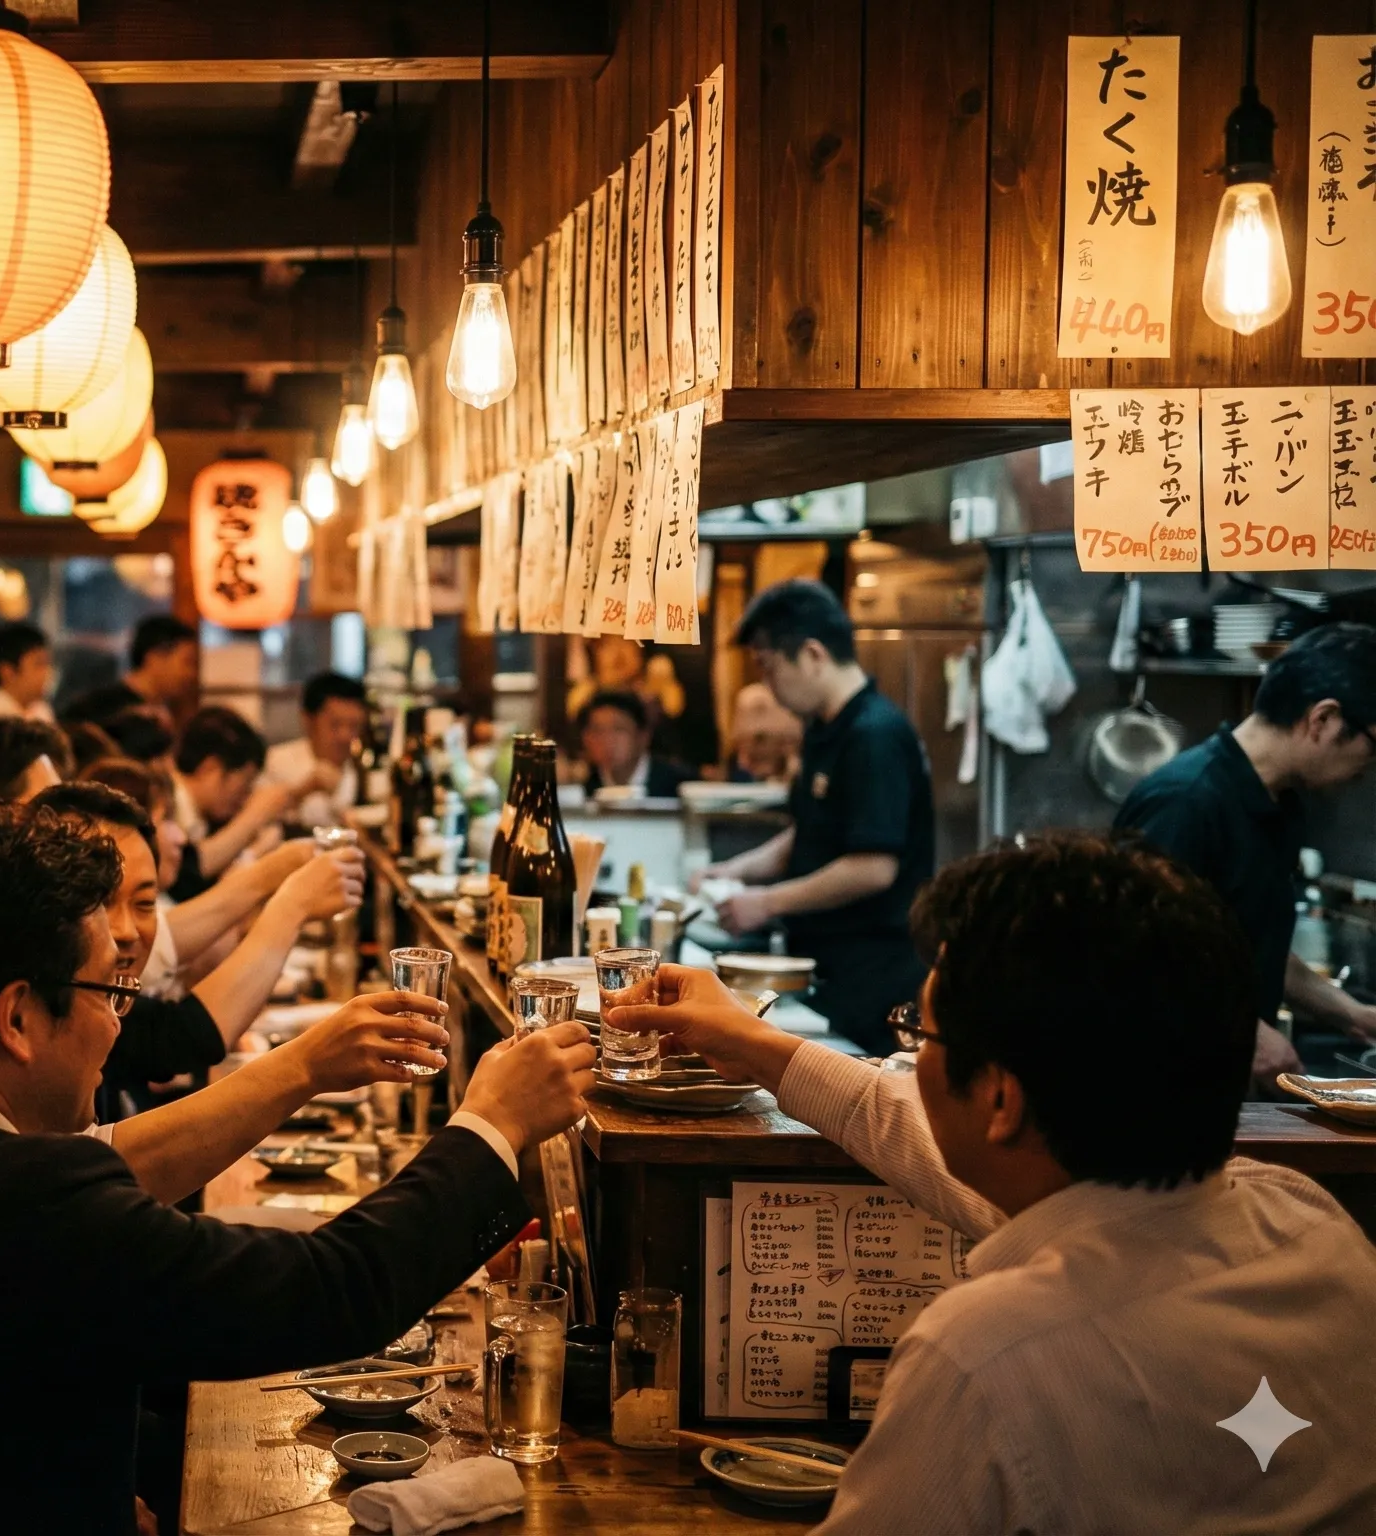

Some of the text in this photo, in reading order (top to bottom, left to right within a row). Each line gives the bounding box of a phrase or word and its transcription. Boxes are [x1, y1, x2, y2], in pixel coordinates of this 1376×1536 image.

[1087, 48, 1157, 227] たく焼
[1069, 296, 1165, 344] 440円
[1082, 528, 1148, 560] 750円
[1219, 521, 1316, 558] 350円
